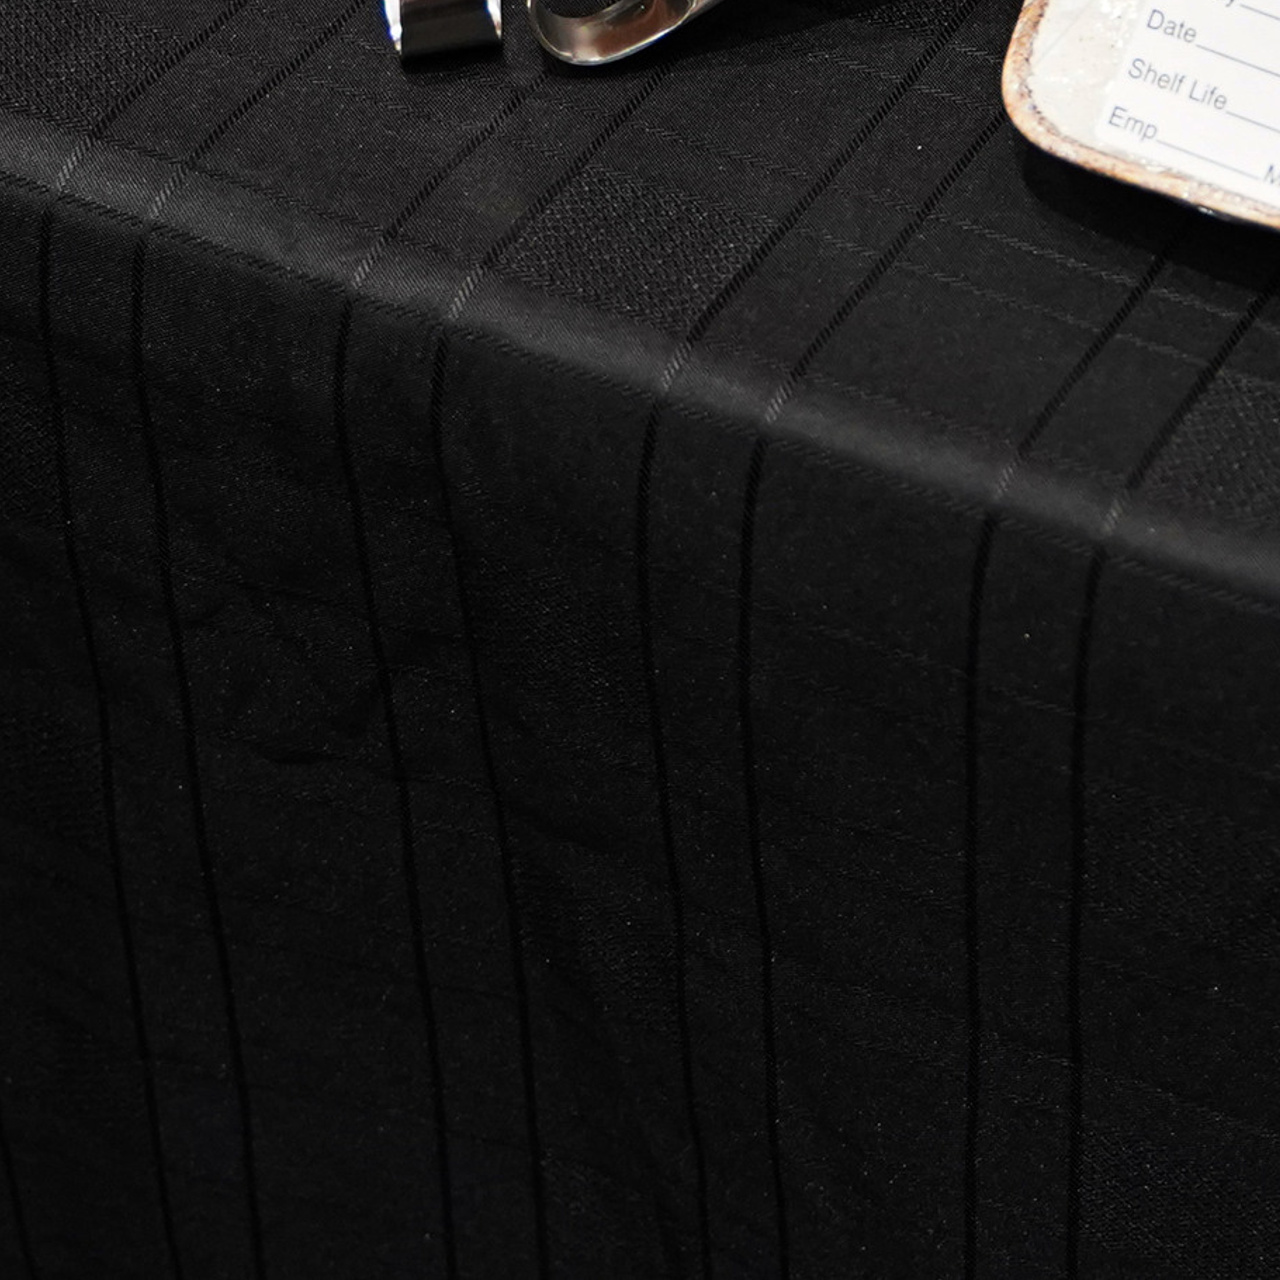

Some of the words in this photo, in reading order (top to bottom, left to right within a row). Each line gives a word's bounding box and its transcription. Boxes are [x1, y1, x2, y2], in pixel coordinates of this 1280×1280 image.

[1146, 8, 1198, 45] Date
[1127, 57, 1186, 98] Shelf
[1189, 81, 1228, 111] Life
[1107, 106, 1159, 143] Emp
